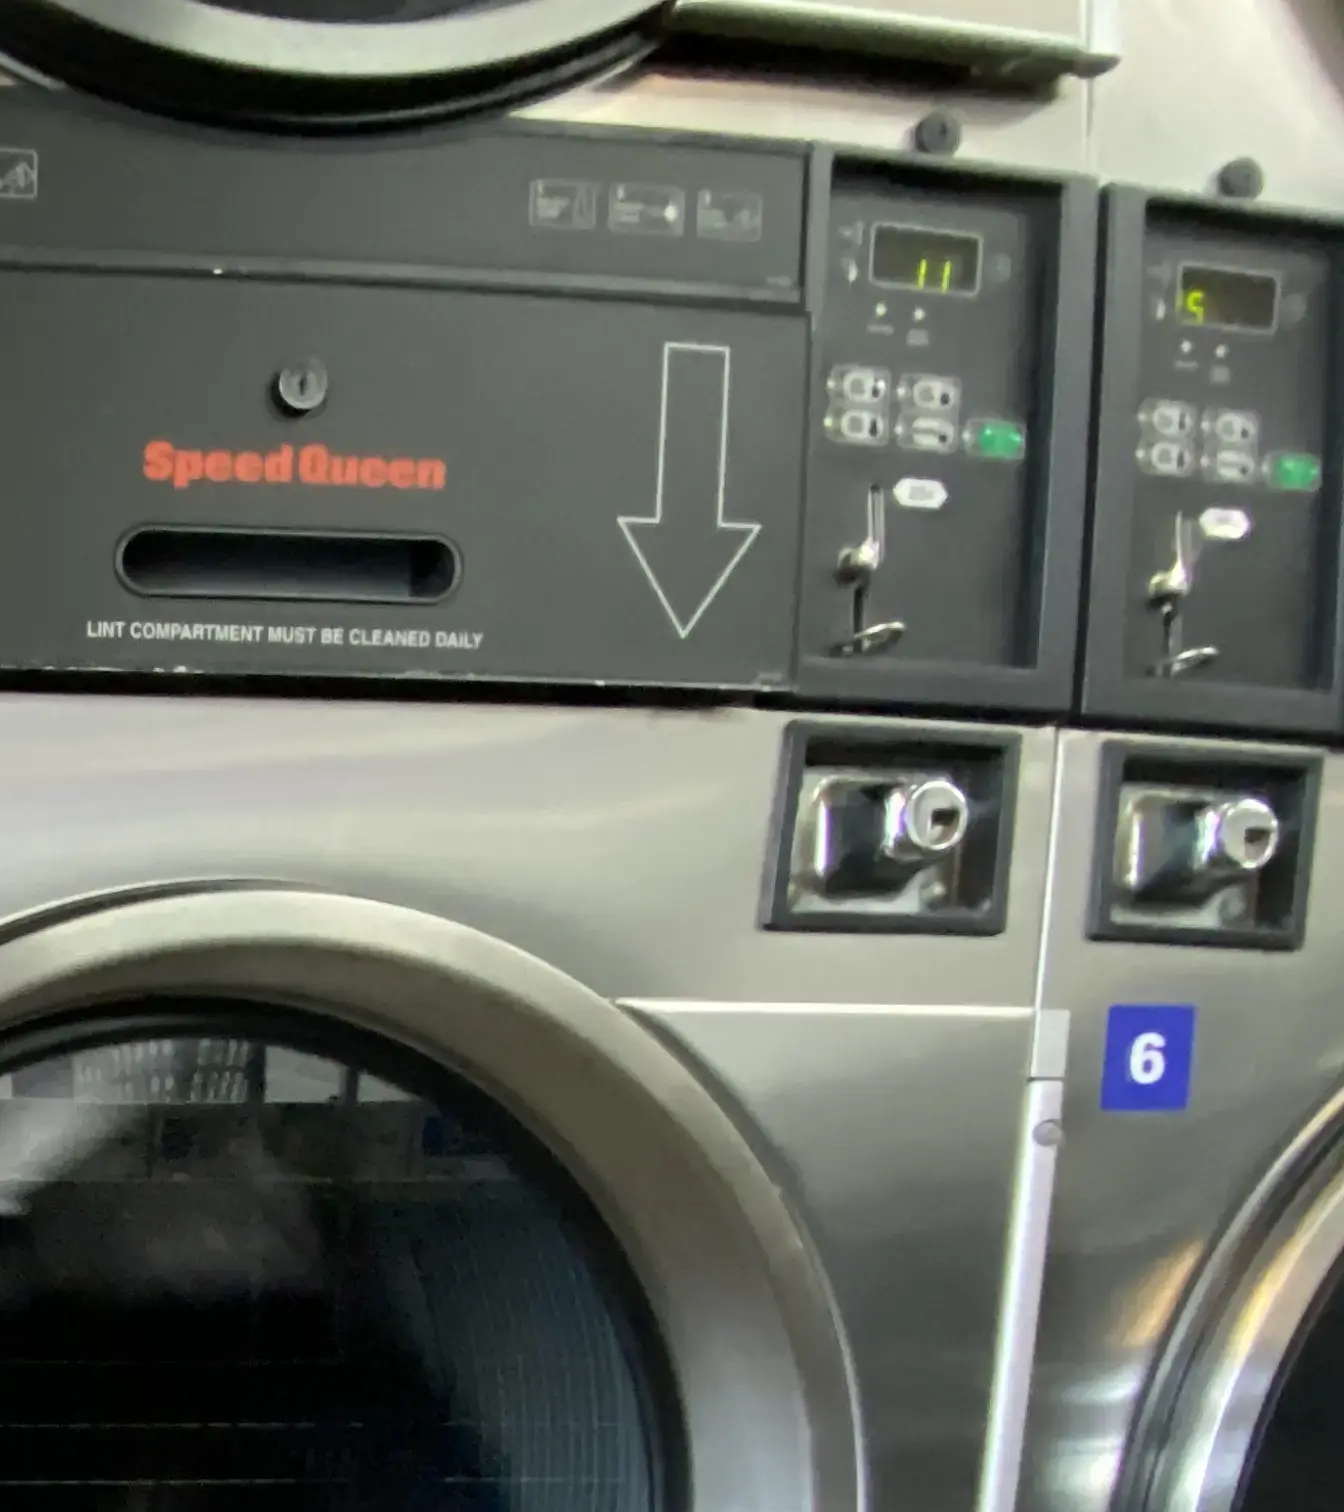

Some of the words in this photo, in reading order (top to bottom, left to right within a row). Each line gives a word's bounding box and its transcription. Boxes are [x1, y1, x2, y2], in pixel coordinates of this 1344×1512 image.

[144, 441, 293, 488] Speed
[298, 444, 445, 489] Queen
[86, 620, 126, 638] LINT
[130, 621, 264, 643] COMPARTMENT
[268, 625, 318, 644] MUST
[321, 627, 344, 645] BE
[349, 628, 430, 648] CLEANED
[435, 630, 484, 650] DAILY
[1129, 1032, 1166, 1084] 6
